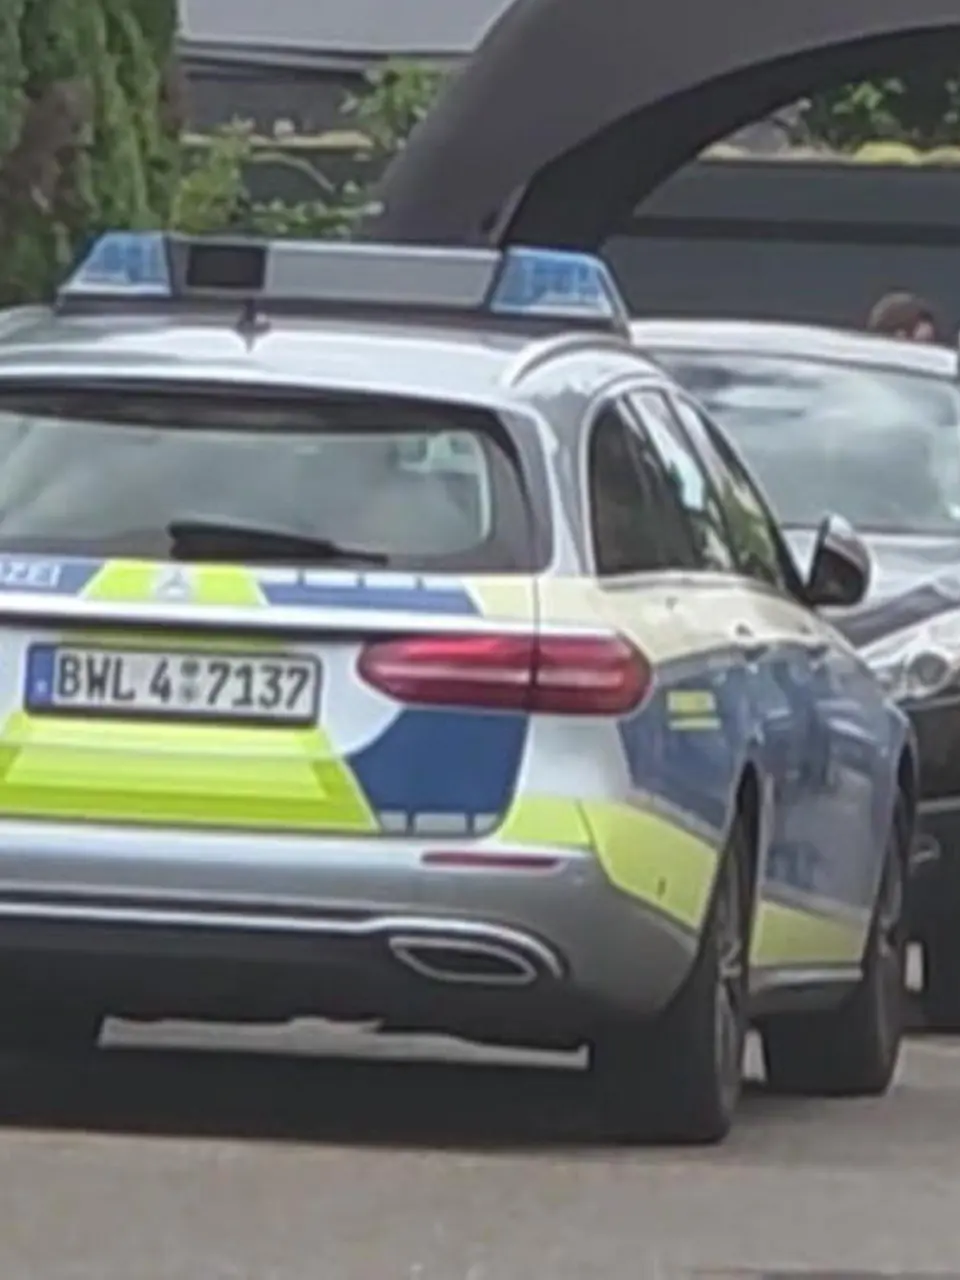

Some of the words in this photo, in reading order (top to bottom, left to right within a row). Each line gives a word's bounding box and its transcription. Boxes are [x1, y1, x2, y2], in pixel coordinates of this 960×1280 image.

[58, 654, 135, 701] BWL
[149, 658, 173, 703] 4
[207, 661, 310, 709] 7137
